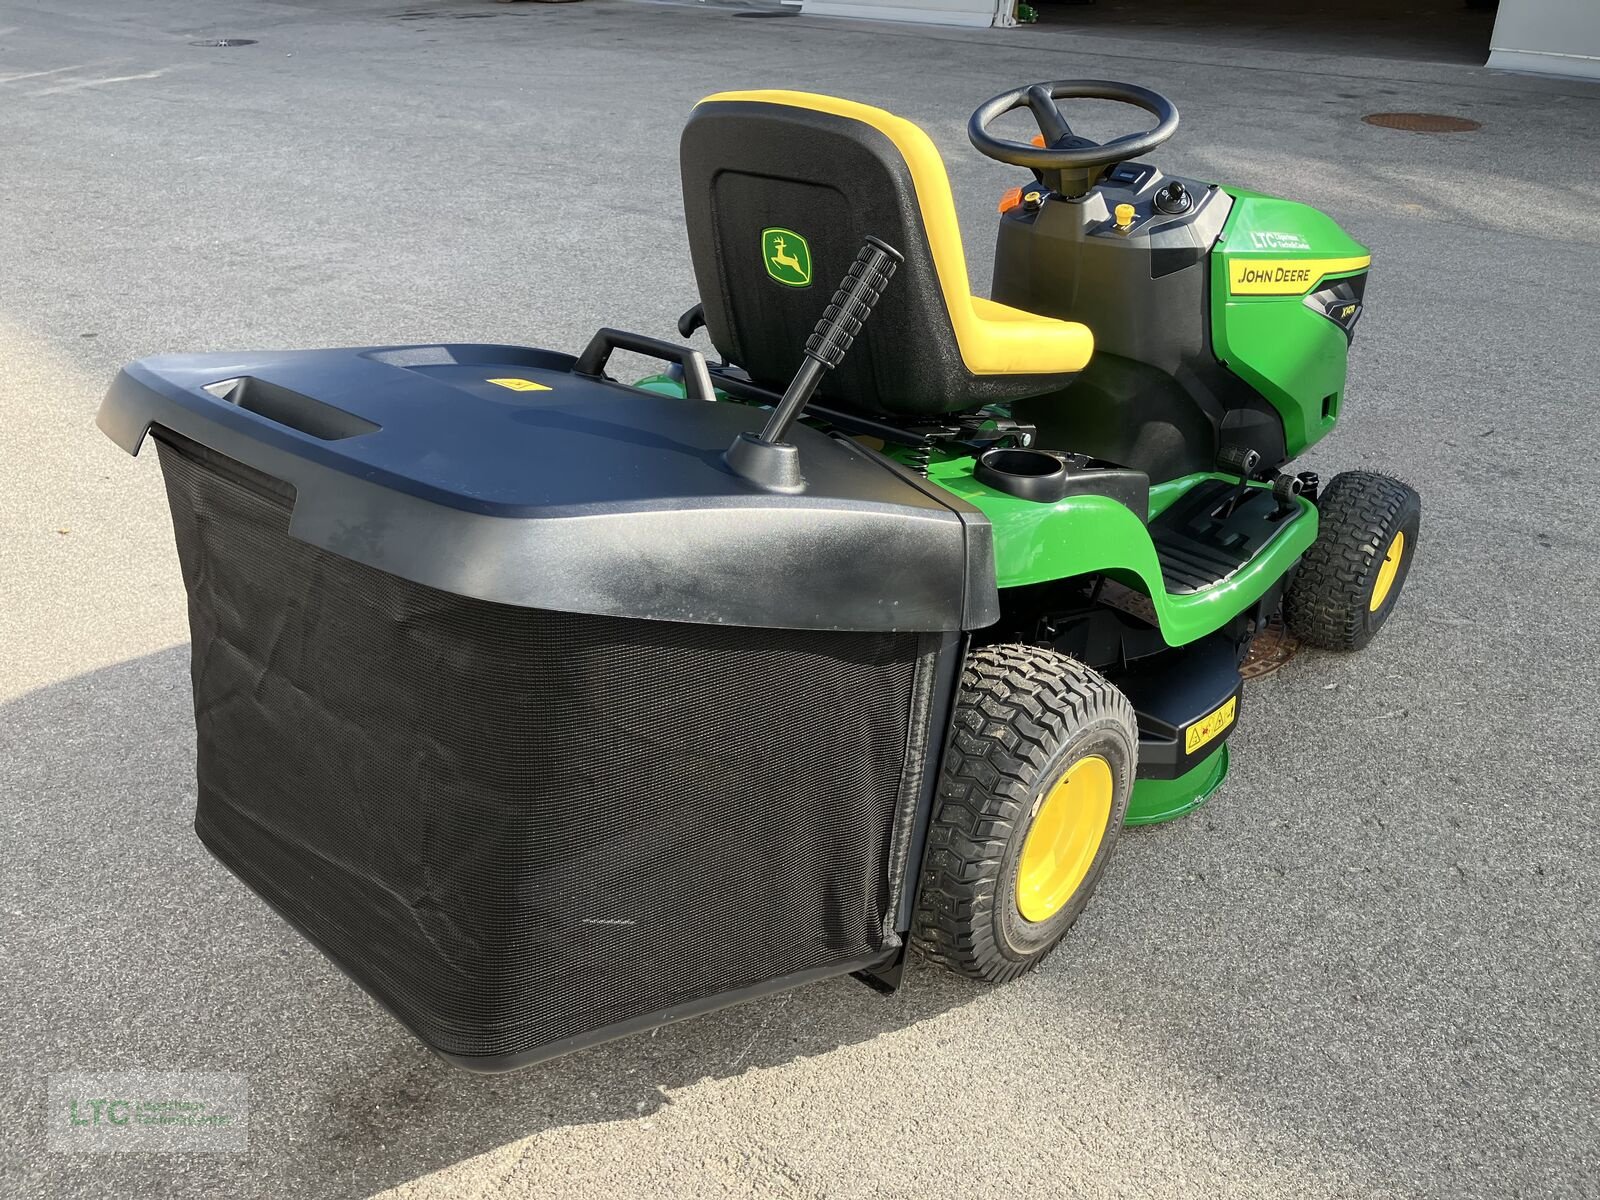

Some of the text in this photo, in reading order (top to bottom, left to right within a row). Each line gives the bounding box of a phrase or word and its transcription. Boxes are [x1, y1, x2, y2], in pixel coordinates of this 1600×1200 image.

[1251, 232, 1277, 248] LTC
[1238, 267, 1311, 283] JOHN DEERE
